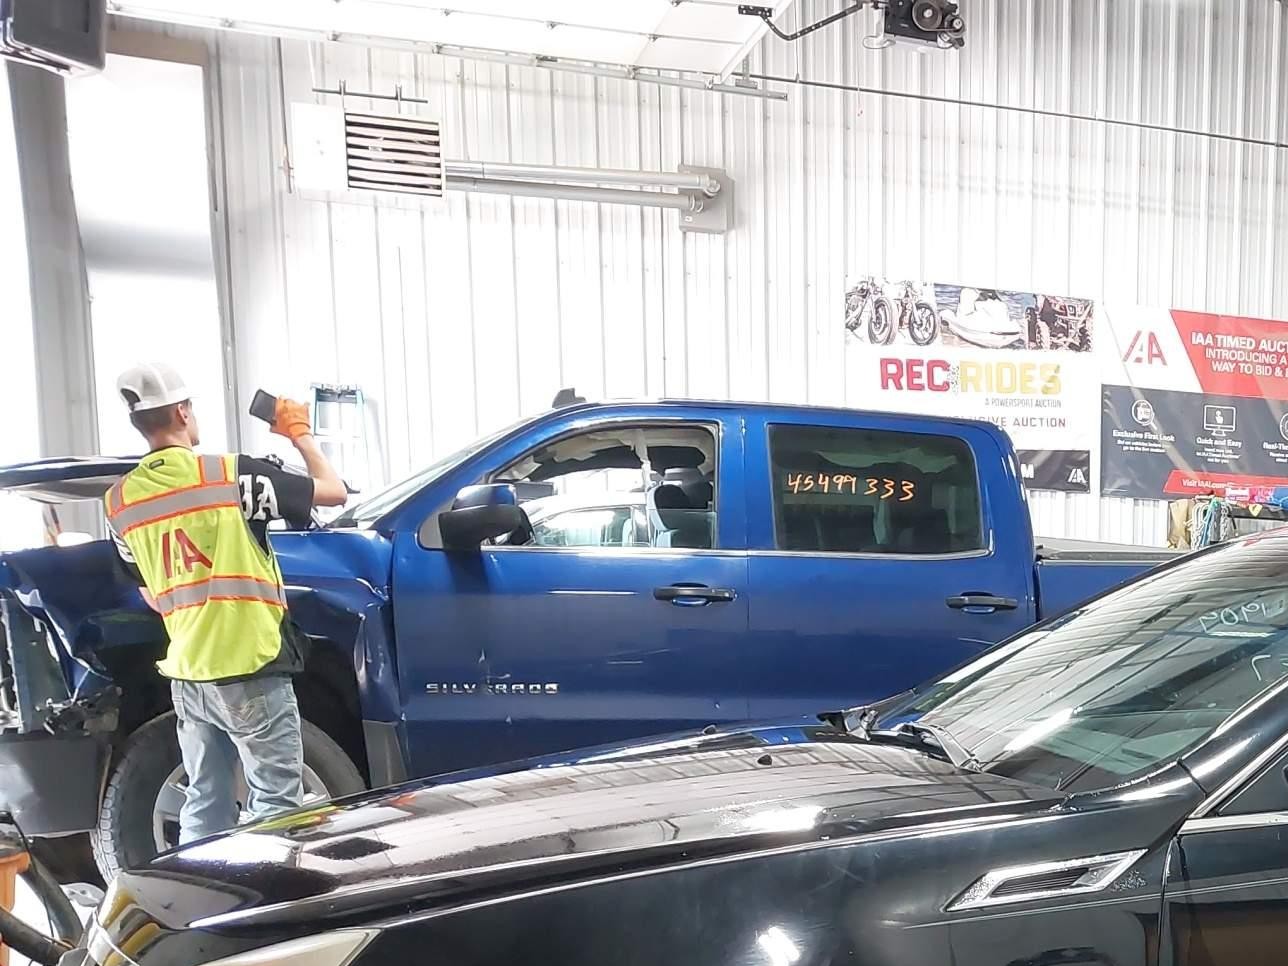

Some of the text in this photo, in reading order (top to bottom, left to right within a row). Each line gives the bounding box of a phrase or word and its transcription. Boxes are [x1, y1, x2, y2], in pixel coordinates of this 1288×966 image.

[1191, 332, 1214, 346] IAA
[1214, 334, 1256, 349] TIMED
[1205, 347, 1277, 365] INTRODUCING
[880, 357, 1062, 395] REC RIDES
[1212, 360, 1236, 372] WAY
[1239, 362, 1253, 374] TO
[1255, 363, 1273, 377] BID
[1274, 366, 1283, 377] &
[1013, 417, 1066, 428] AUCTION
[425, 682, 559, 695] SILVRADO
